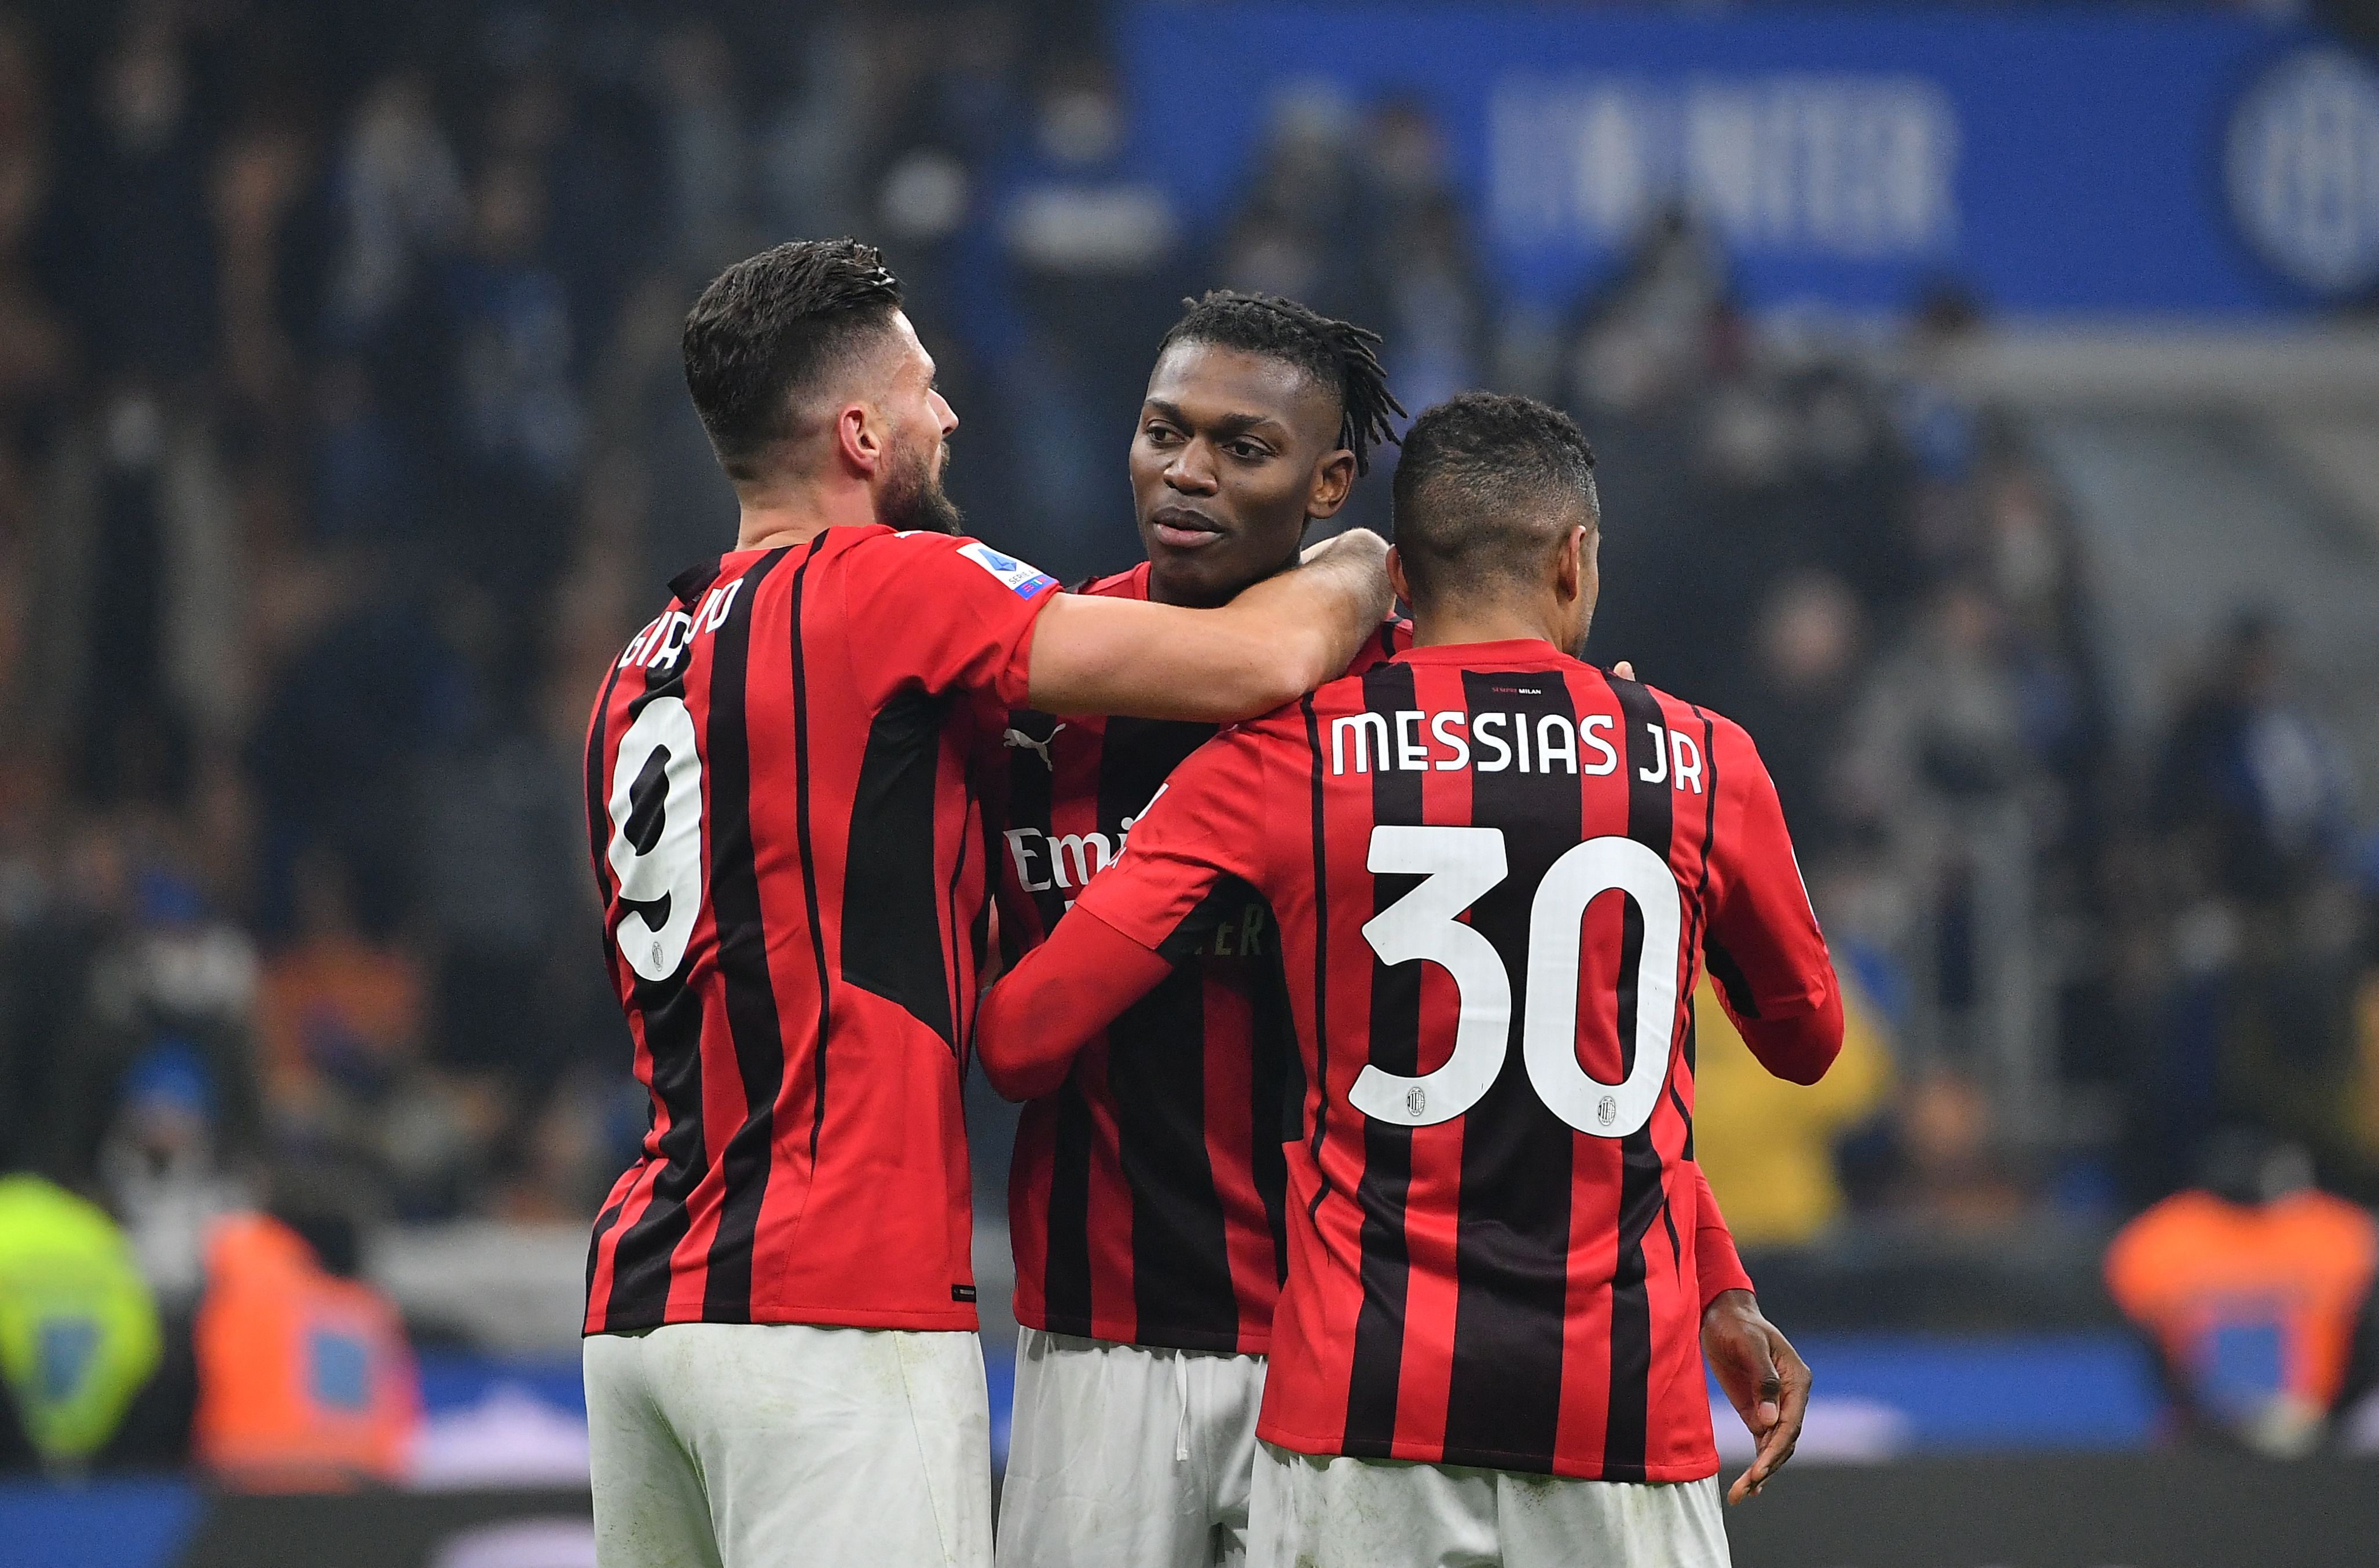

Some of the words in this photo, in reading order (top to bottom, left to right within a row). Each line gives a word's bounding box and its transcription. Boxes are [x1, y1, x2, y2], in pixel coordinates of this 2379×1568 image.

[1009, 571, 1030, 585] SERIE
[608, 696, 703, 982] 9
[1332, 710, 1618, 776] MESSIAS
[1638, 722, 1703, 794] JR
[1348, 825, 1681, 1139] 30
